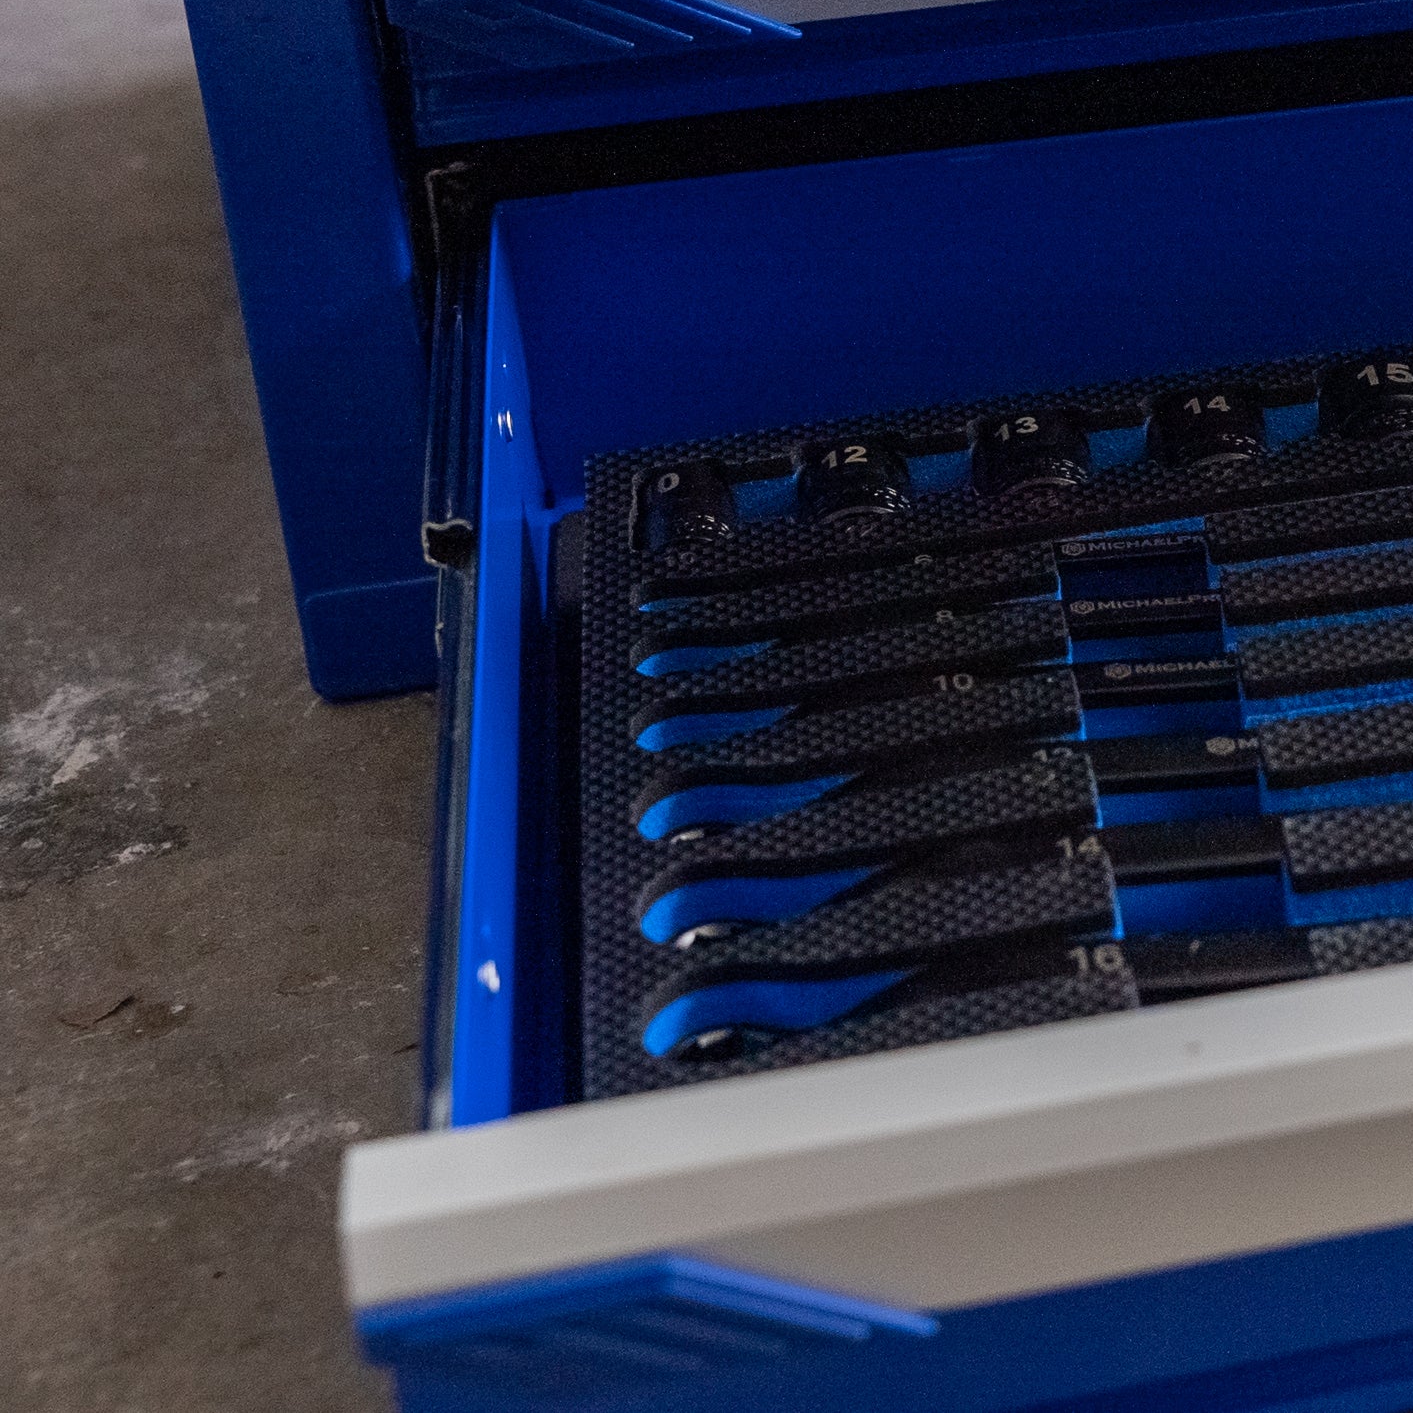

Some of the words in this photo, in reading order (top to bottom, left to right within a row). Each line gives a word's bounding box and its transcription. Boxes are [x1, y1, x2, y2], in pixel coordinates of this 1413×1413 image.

[1183, 395, 1232, 415] 14
[993, 415, 1040, 442] 13
[820, 445, 869, 469] 12
[932, 672, 976, 693] 10
[1056, 834, 1102, 860] 14
[1067, 943, 1126, 973] 16
